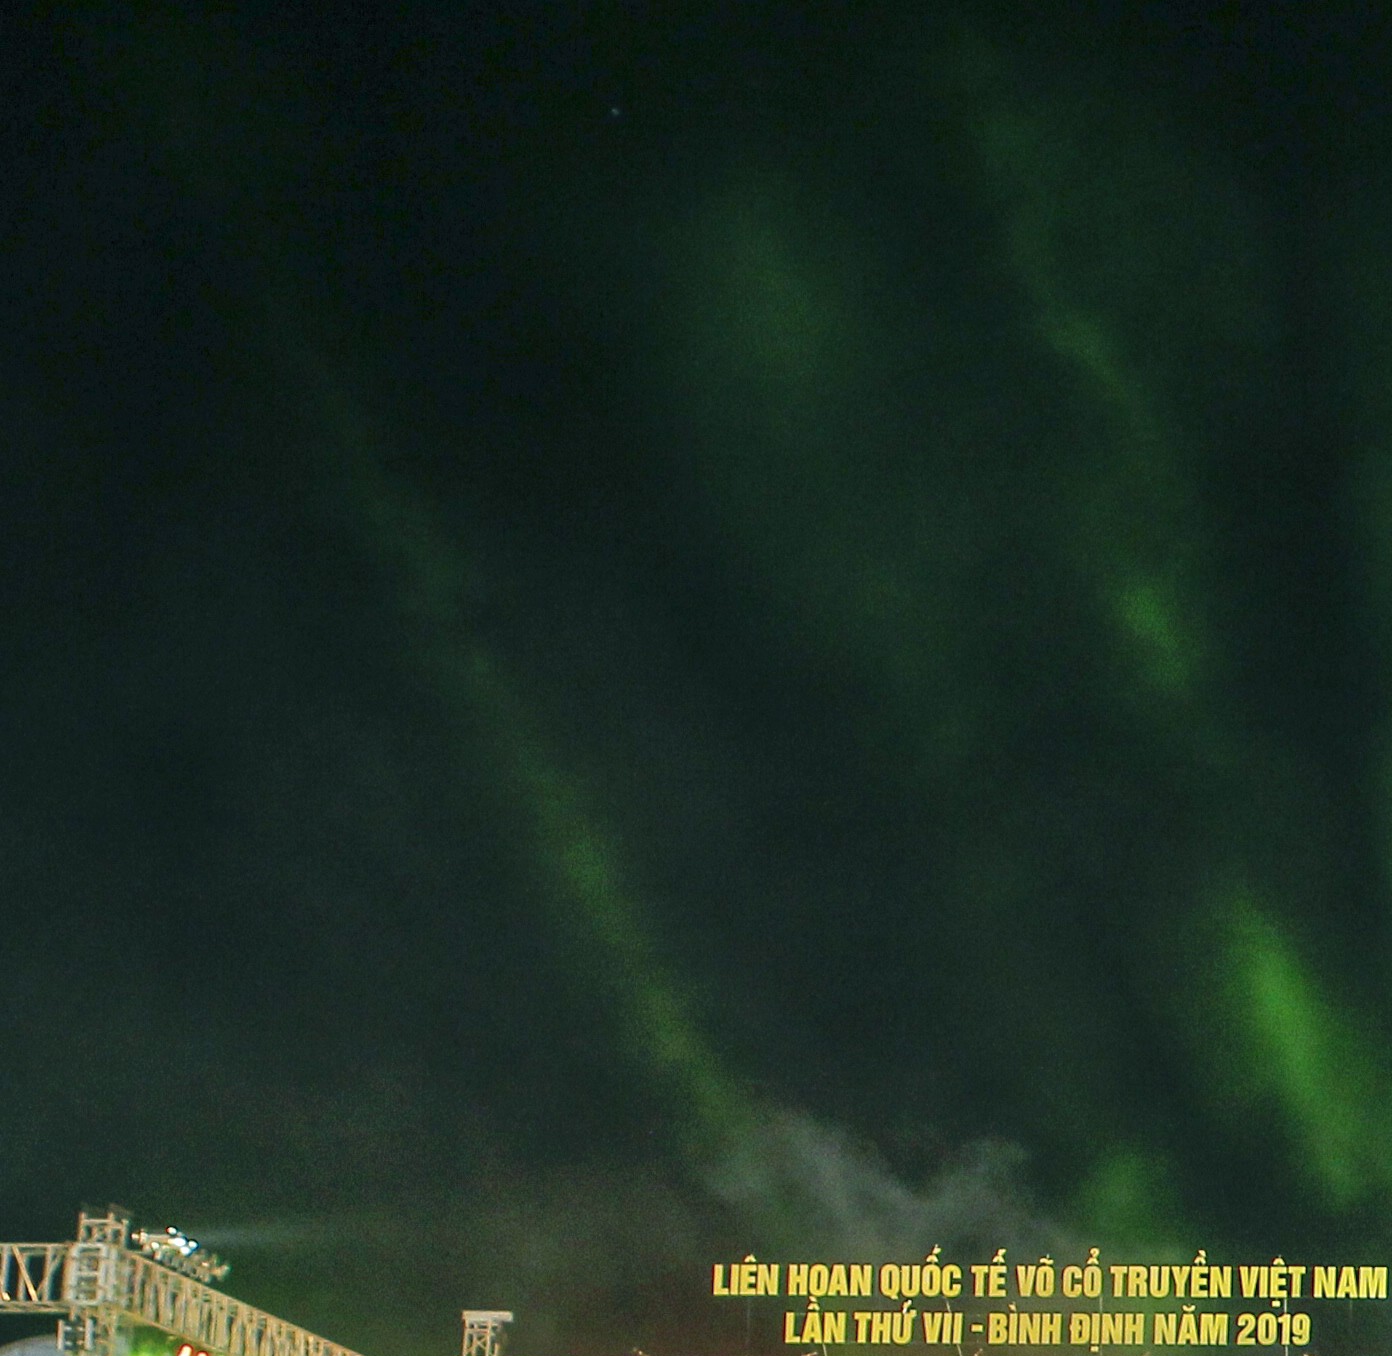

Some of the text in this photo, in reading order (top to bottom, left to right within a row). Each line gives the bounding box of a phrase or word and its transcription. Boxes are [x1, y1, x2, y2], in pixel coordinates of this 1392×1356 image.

[713, 1244, 1388, 1307] LIÊN HOAN QUỐC TẾ VÕ CỔ TRUYỀN VIỆT NAM
[784, 1296, 847, 1344] LẦN
[854, 1299, 917, 1344] THỨ
[923, 1312, 963, 1344] VII
[988, 1302, 1062, 1345] BÌNH
[1070, 1312, 1144, 1352] ĐỊNH
[1154, 1304, 1228, 1345] NĂM
[1237, 1312, 1311, 1345] 2019
